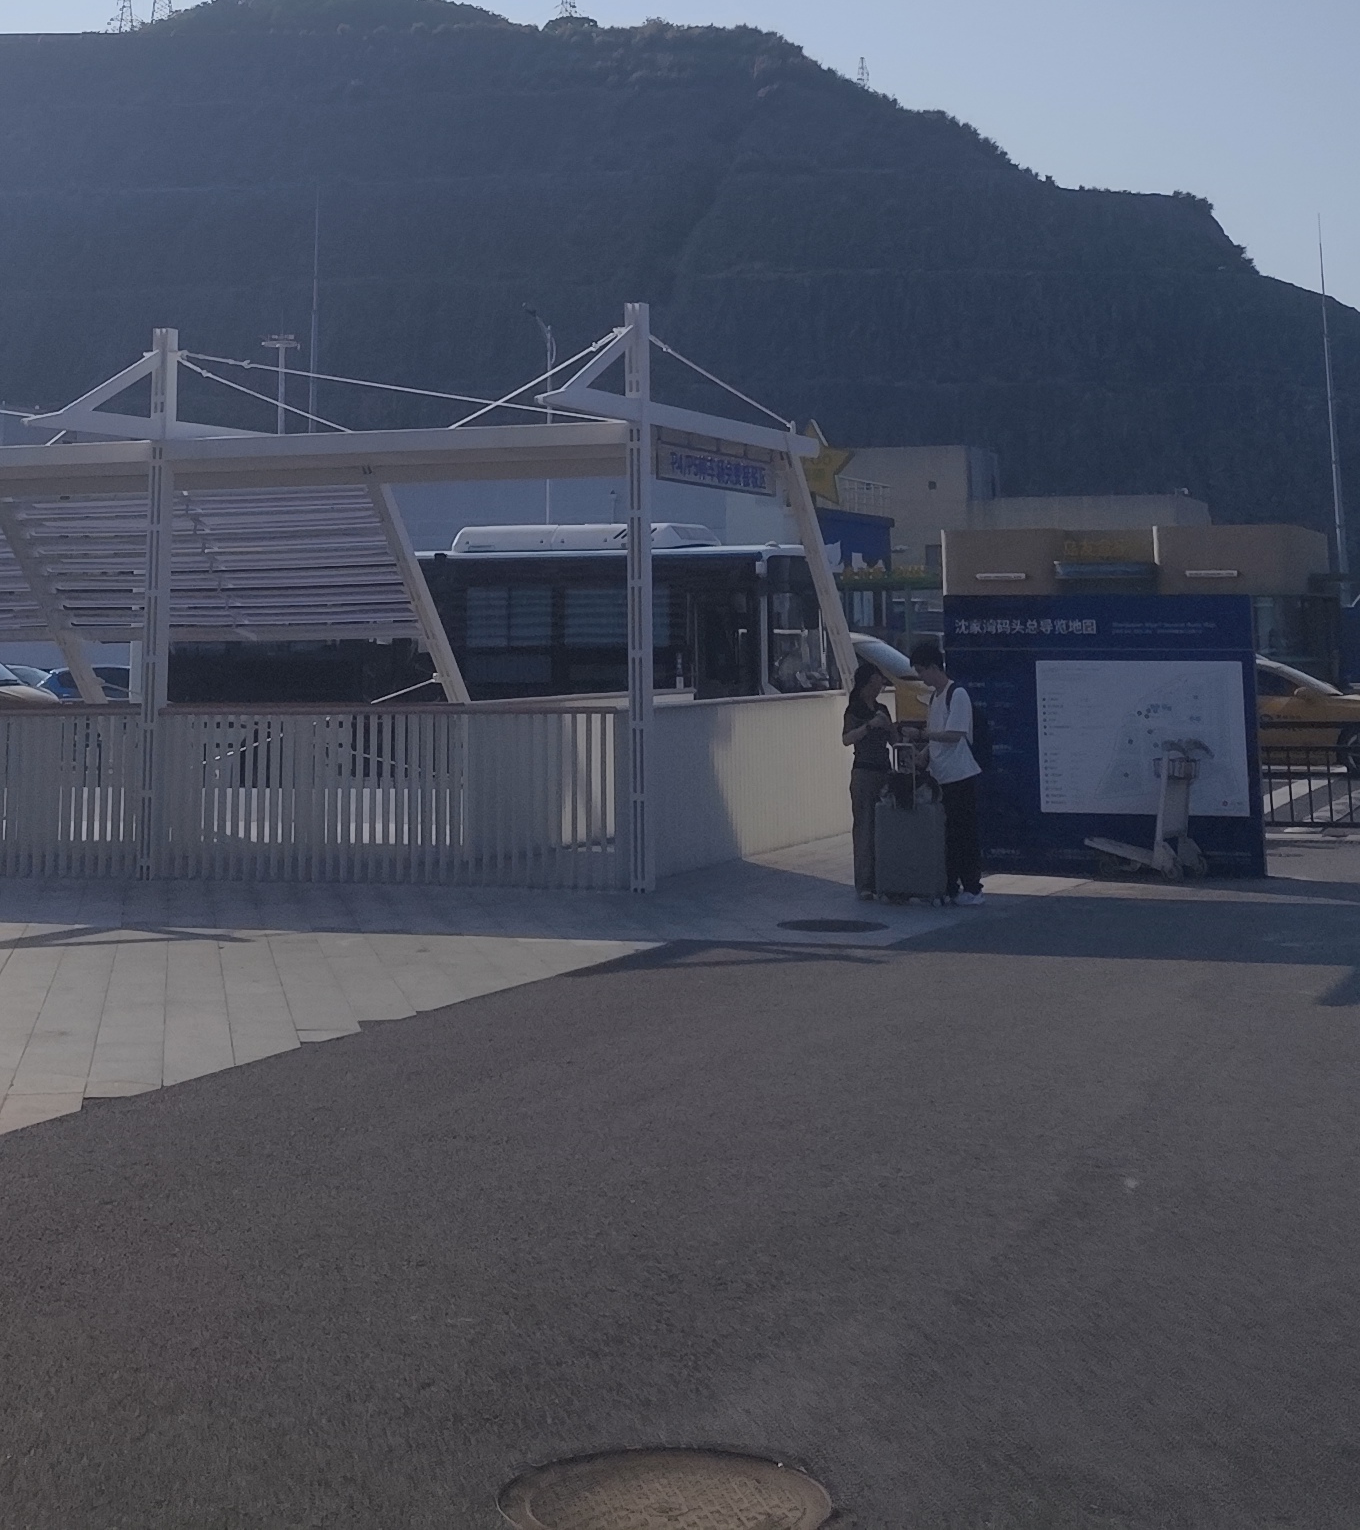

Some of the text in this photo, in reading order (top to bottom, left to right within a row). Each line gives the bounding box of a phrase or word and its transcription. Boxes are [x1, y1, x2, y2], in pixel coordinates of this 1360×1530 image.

[955, 619, 1097, 635] 沈家湾码头总导览地图
